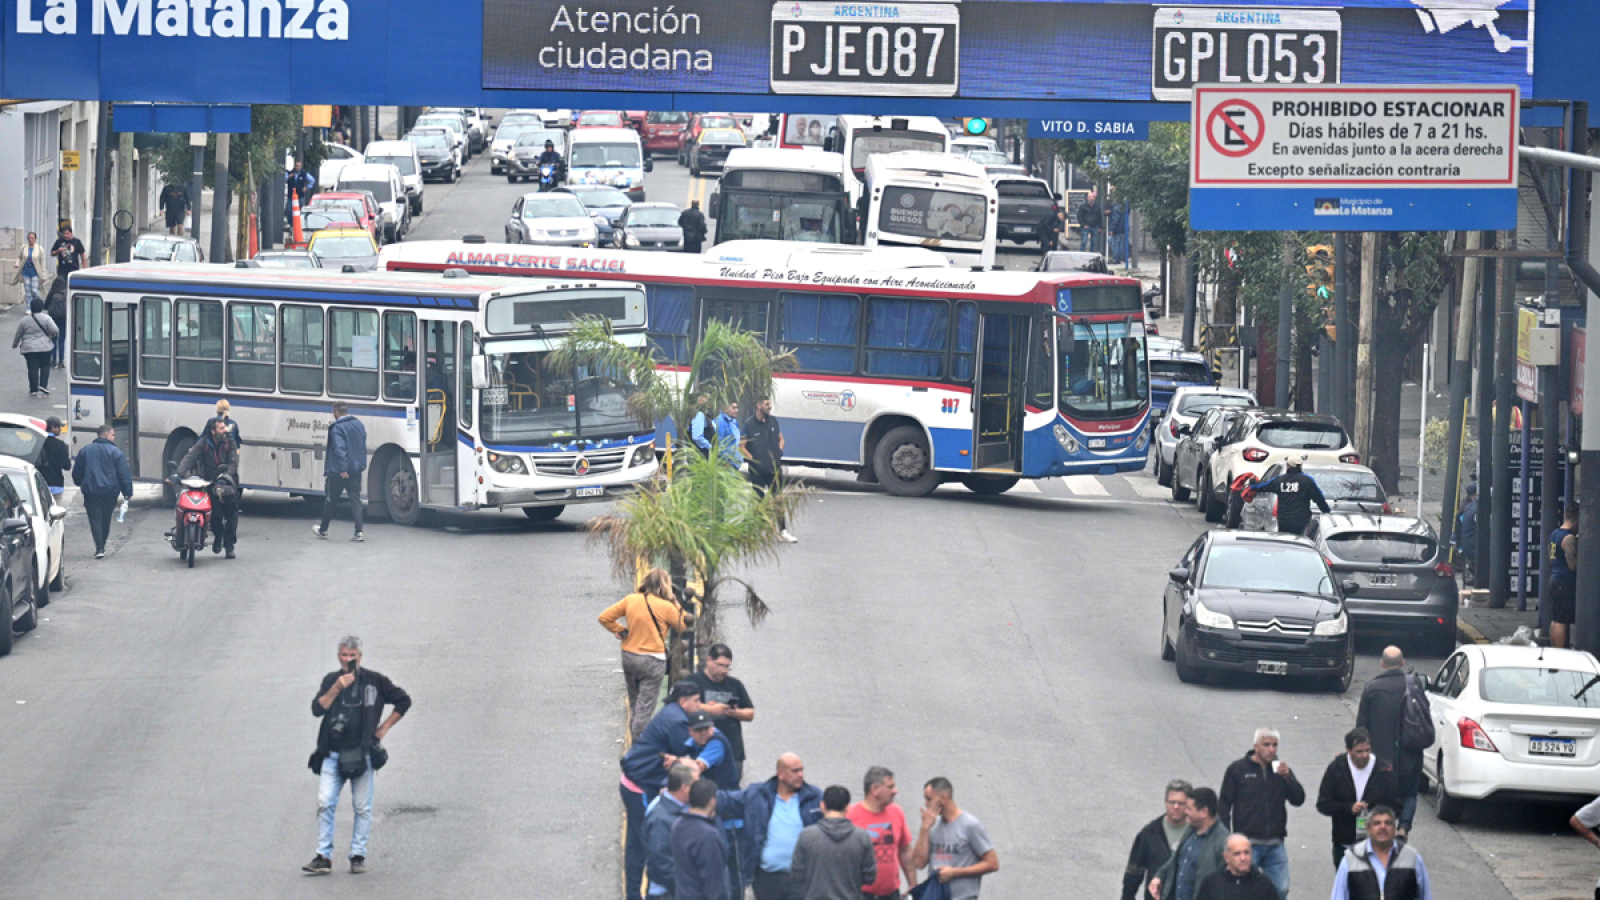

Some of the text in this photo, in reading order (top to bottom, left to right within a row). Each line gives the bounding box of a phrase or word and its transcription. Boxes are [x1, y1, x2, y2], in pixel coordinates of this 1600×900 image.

[834, 5, 899, 18] ARGENTINA
[1215, 12, 1281, 24] ARGENTINA
[16, 0, 349, 41] La Matanza
[550, 5, 701, 35] Atención
[538, 41, 713, 71] ciudadana
[782, 24, 946, 77] PJE087
[1163, 31, 1326, 83] GPL053
[1272, 101, 1505, 118] PROHIBIDO ESTACIONAR
[1041, 120, 1135, 134] VITO D. SABIA
[1289, 121, 1488, 139] Días hábiles de 7 a 21 hs.
[1273, 143, 1504, 158] En avenidas junto a la acera derecha
[1248, 163, 1461, 178] Excepto señalización contraria
[890, 207, 924, 217] BUENOS
[1339, 206, 1393, 216] La Matanza
[890, 214, 923, 225] QUESOS
[445, 251, 561, 270] ALMAFUERTE
[719, 267, 976, 290] Unidad Piso Bajo Equipada con Aire Acondicionado
[1531, 742, 1542, 750] AD
[1544, 742, 1560, 752] 524
